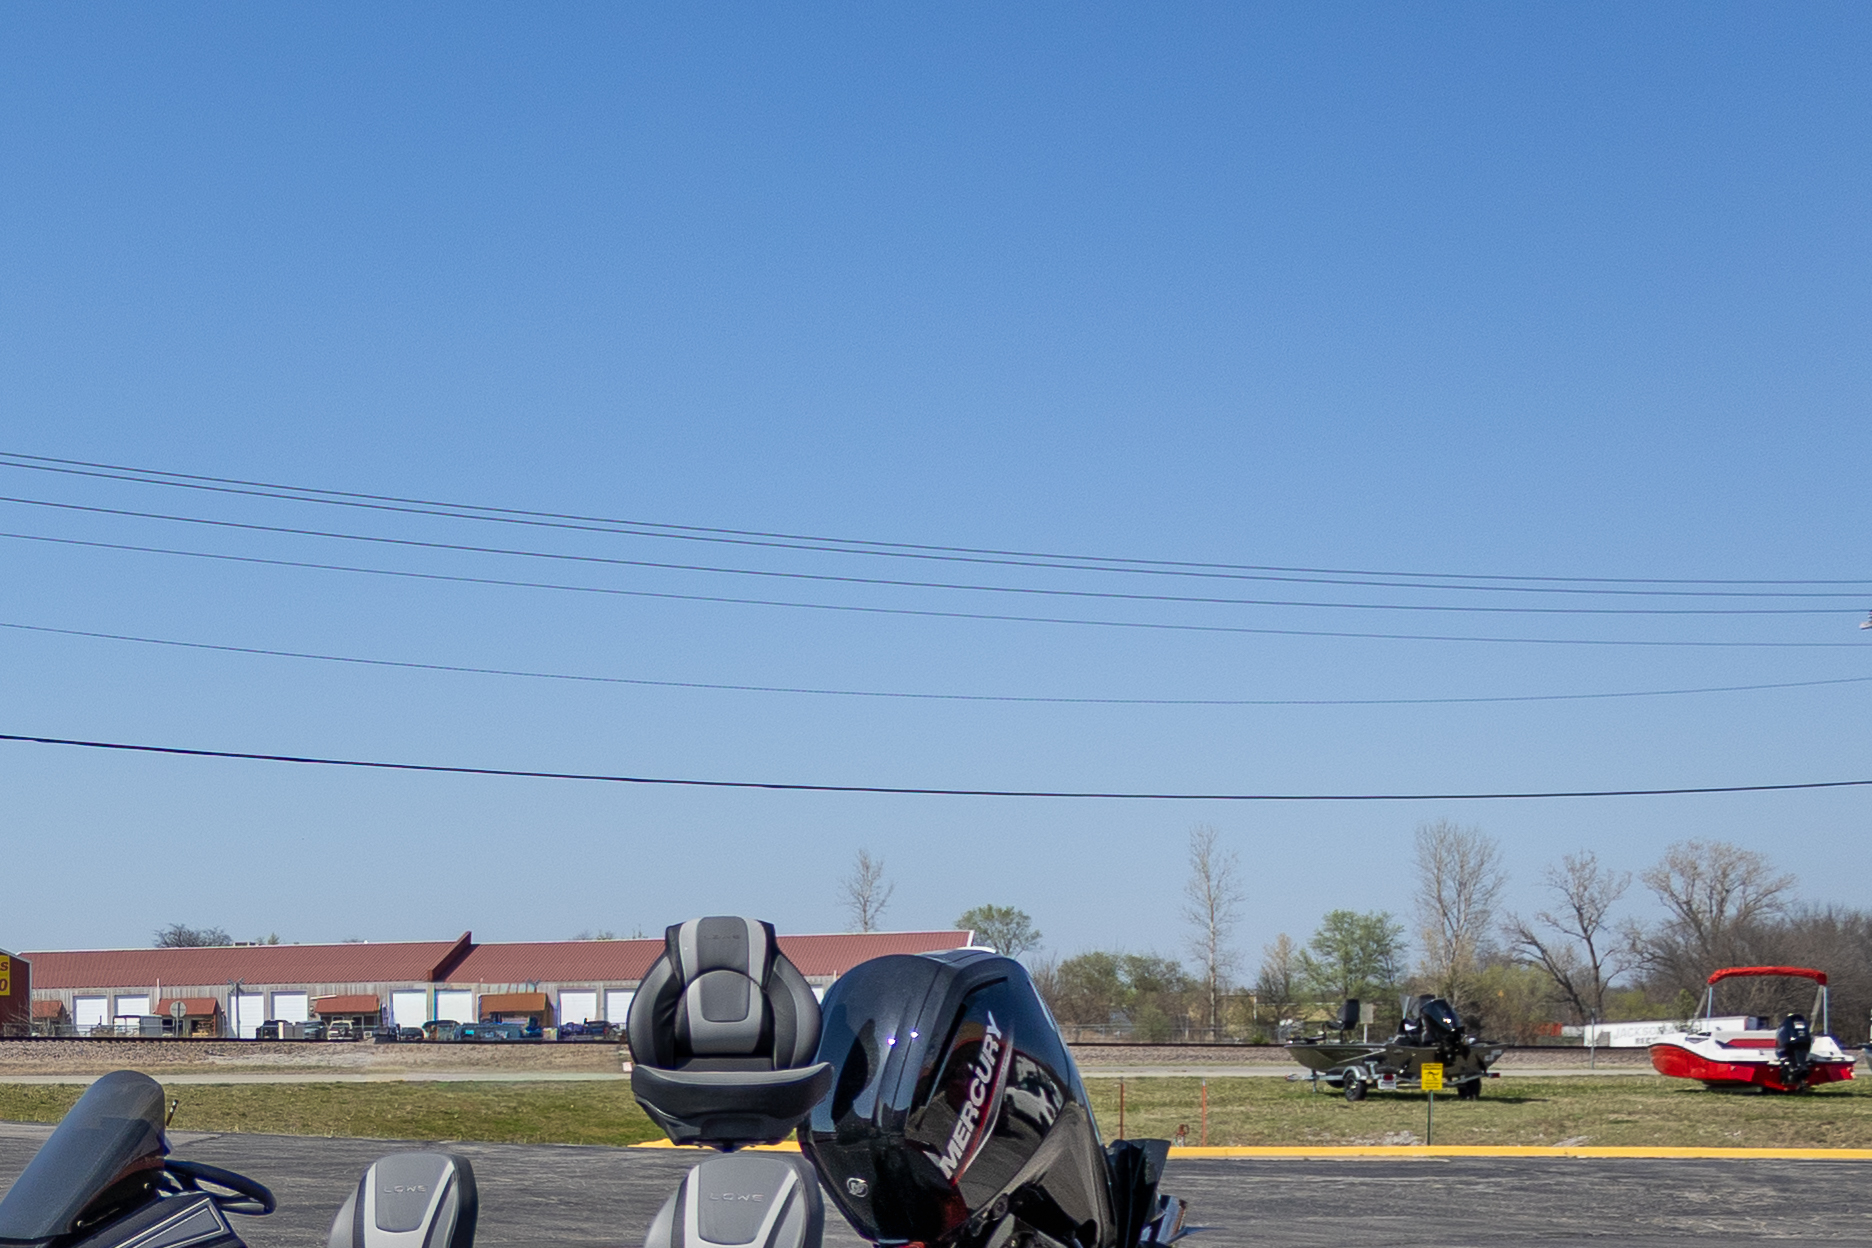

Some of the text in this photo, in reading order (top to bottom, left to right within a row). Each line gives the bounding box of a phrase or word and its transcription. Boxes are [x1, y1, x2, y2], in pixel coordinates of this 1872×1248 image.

[939, 1010, 1002, 1180] MERCURY
[383, 1184, 427, 1193] LOWE
[709, 1192, 764, 1202] LOWE
